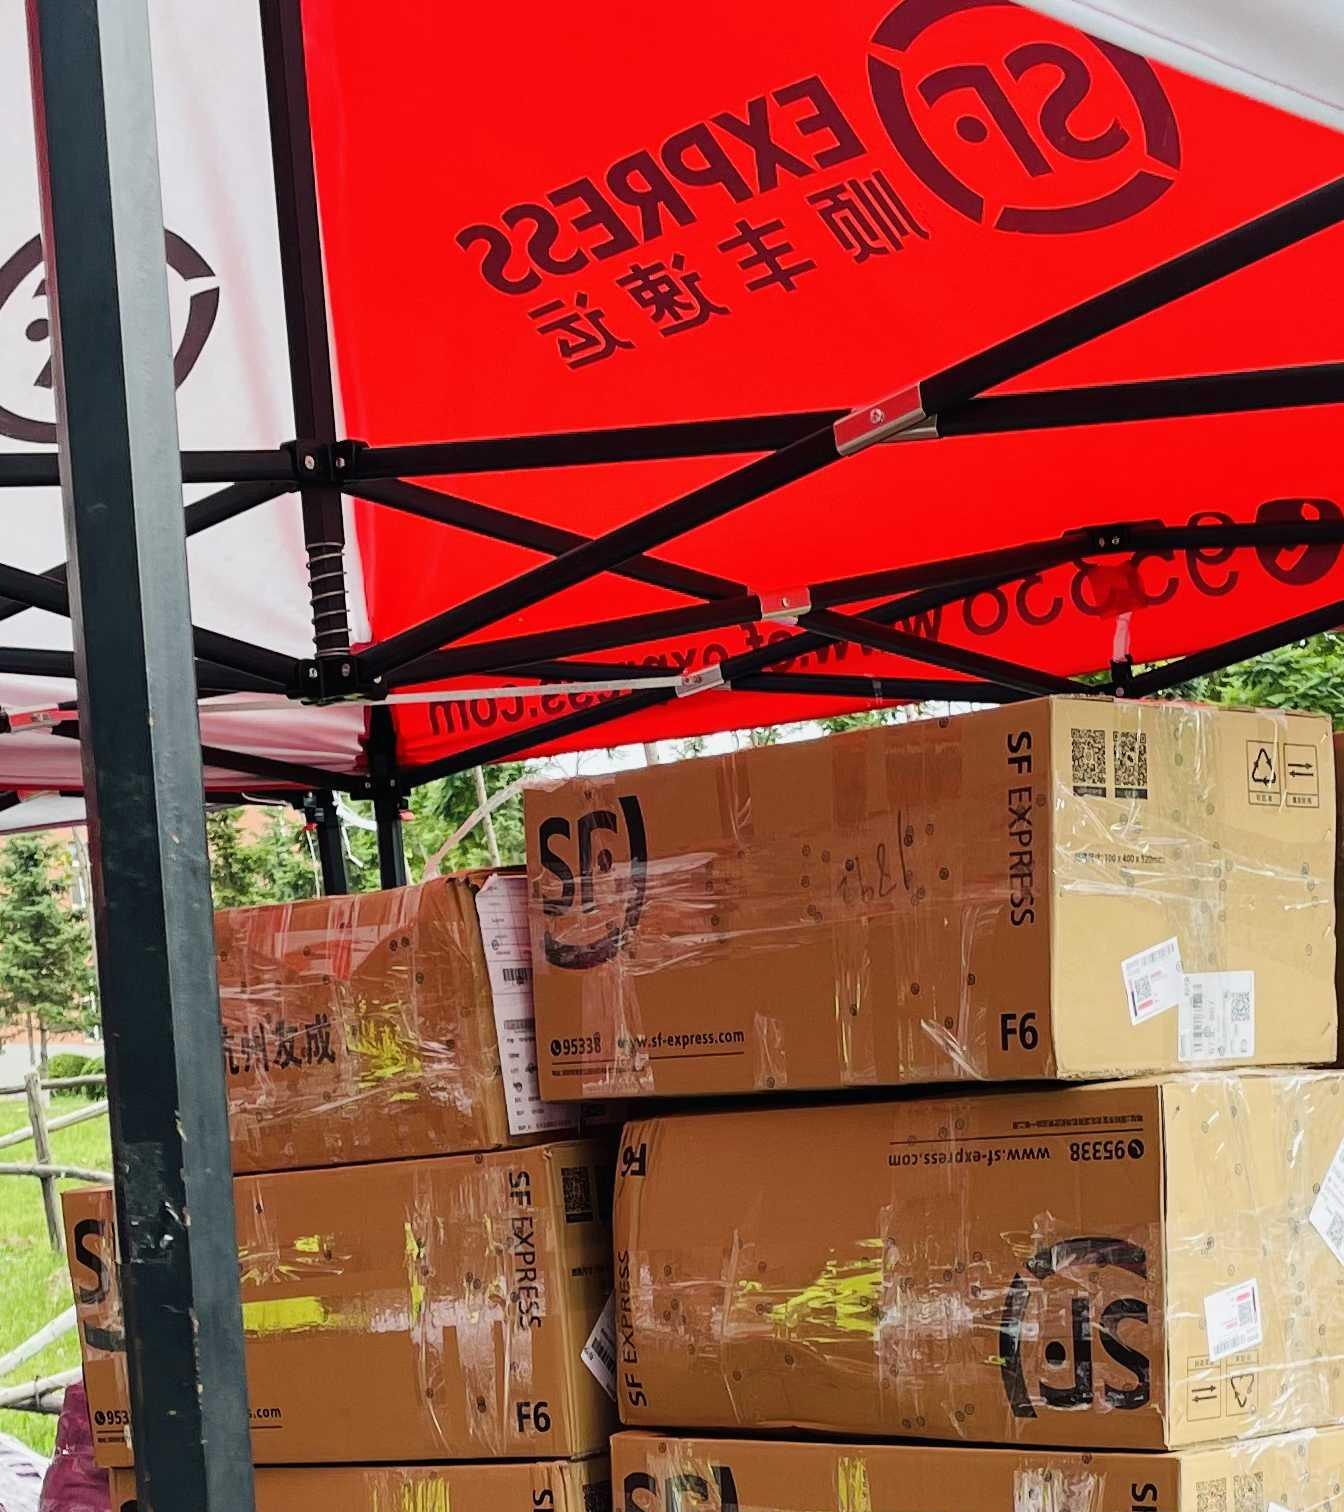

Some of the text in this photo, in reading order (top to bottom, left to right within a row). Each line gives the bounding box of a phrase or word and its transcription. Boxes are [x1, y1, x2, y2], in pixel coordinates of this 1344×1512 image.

[1006, 729, 1036, 927] SF EXPRESS
[562, 1036, 602, 1056] 95338
[1000, 1011, 1040, 1052] F6
[888, 1140, 1127, 1168] 95338 www.sf-express.com
[509, 1170, 542, 1331] SF EXPRESS
[1040, 1298, 1150, 1410] SF
[516, 1401, 551, 1436] F6
